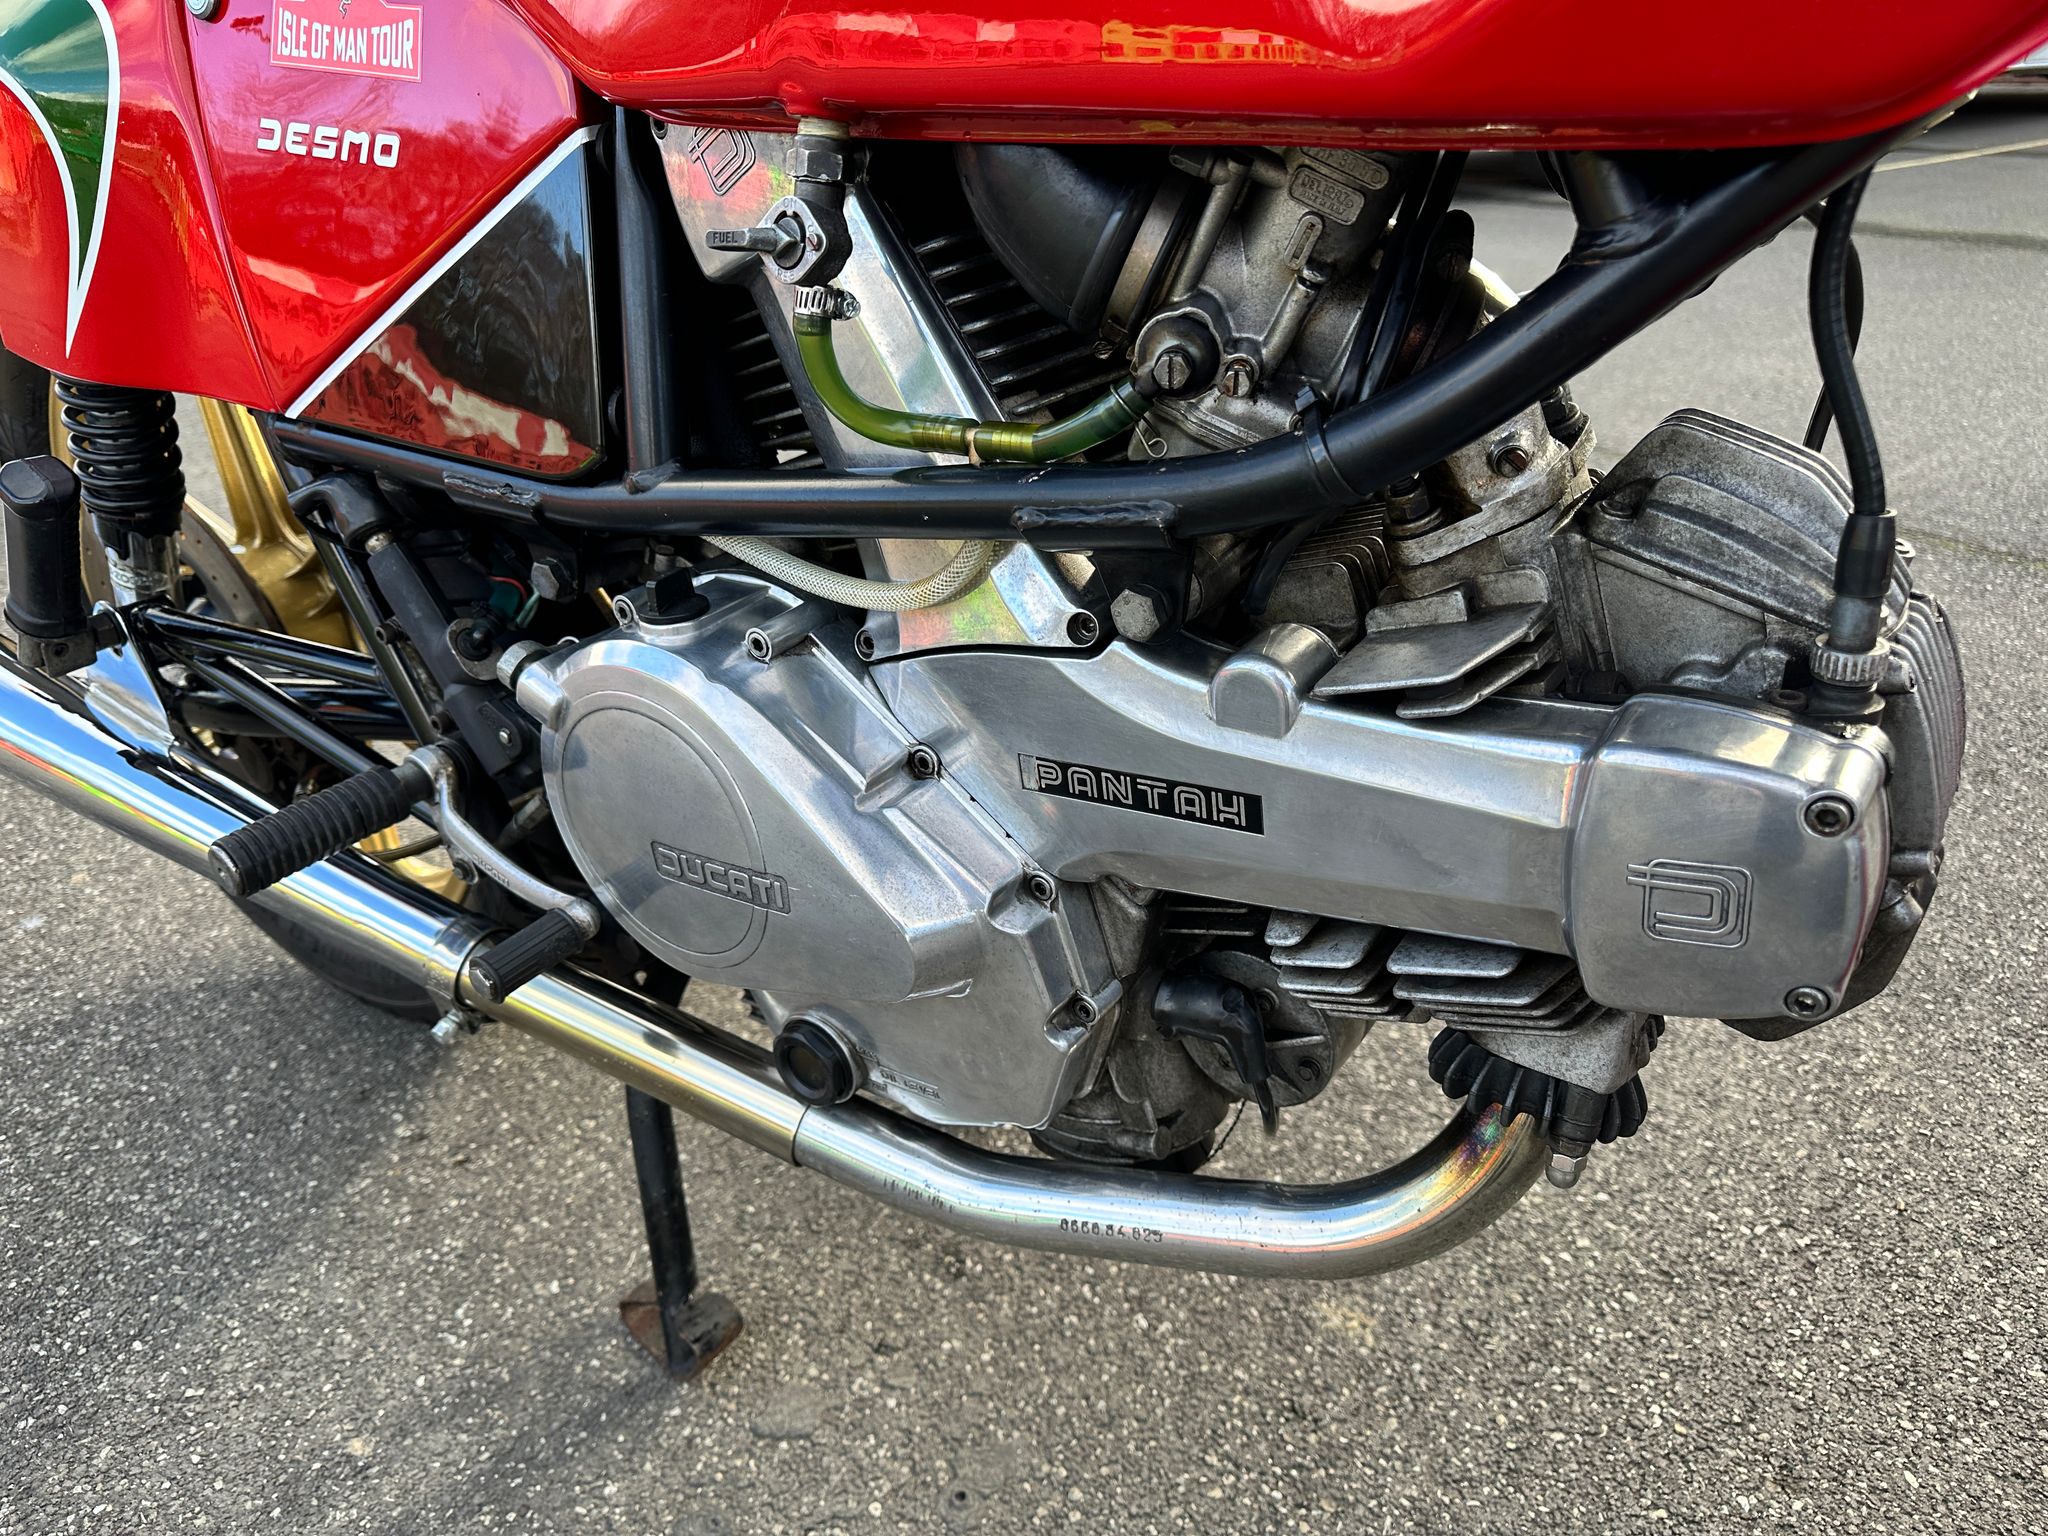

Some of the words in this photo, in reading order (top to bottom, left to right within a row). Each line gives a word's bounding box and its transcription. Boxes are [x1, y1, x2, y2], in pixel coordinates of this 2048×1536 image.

[277, 7, 309, 58] ISLE
[311, 22, 331, 60] OF
[333, 27, 367, 64] MAN
[371, 19, 414, 69] TOUR
[257, 117, 401, 168] DESMO
[712, 231, 738, 245] FUEL
[1035, 759, 1247, 827] PANTAH
[658, 847, 784, 909] DUCATI
